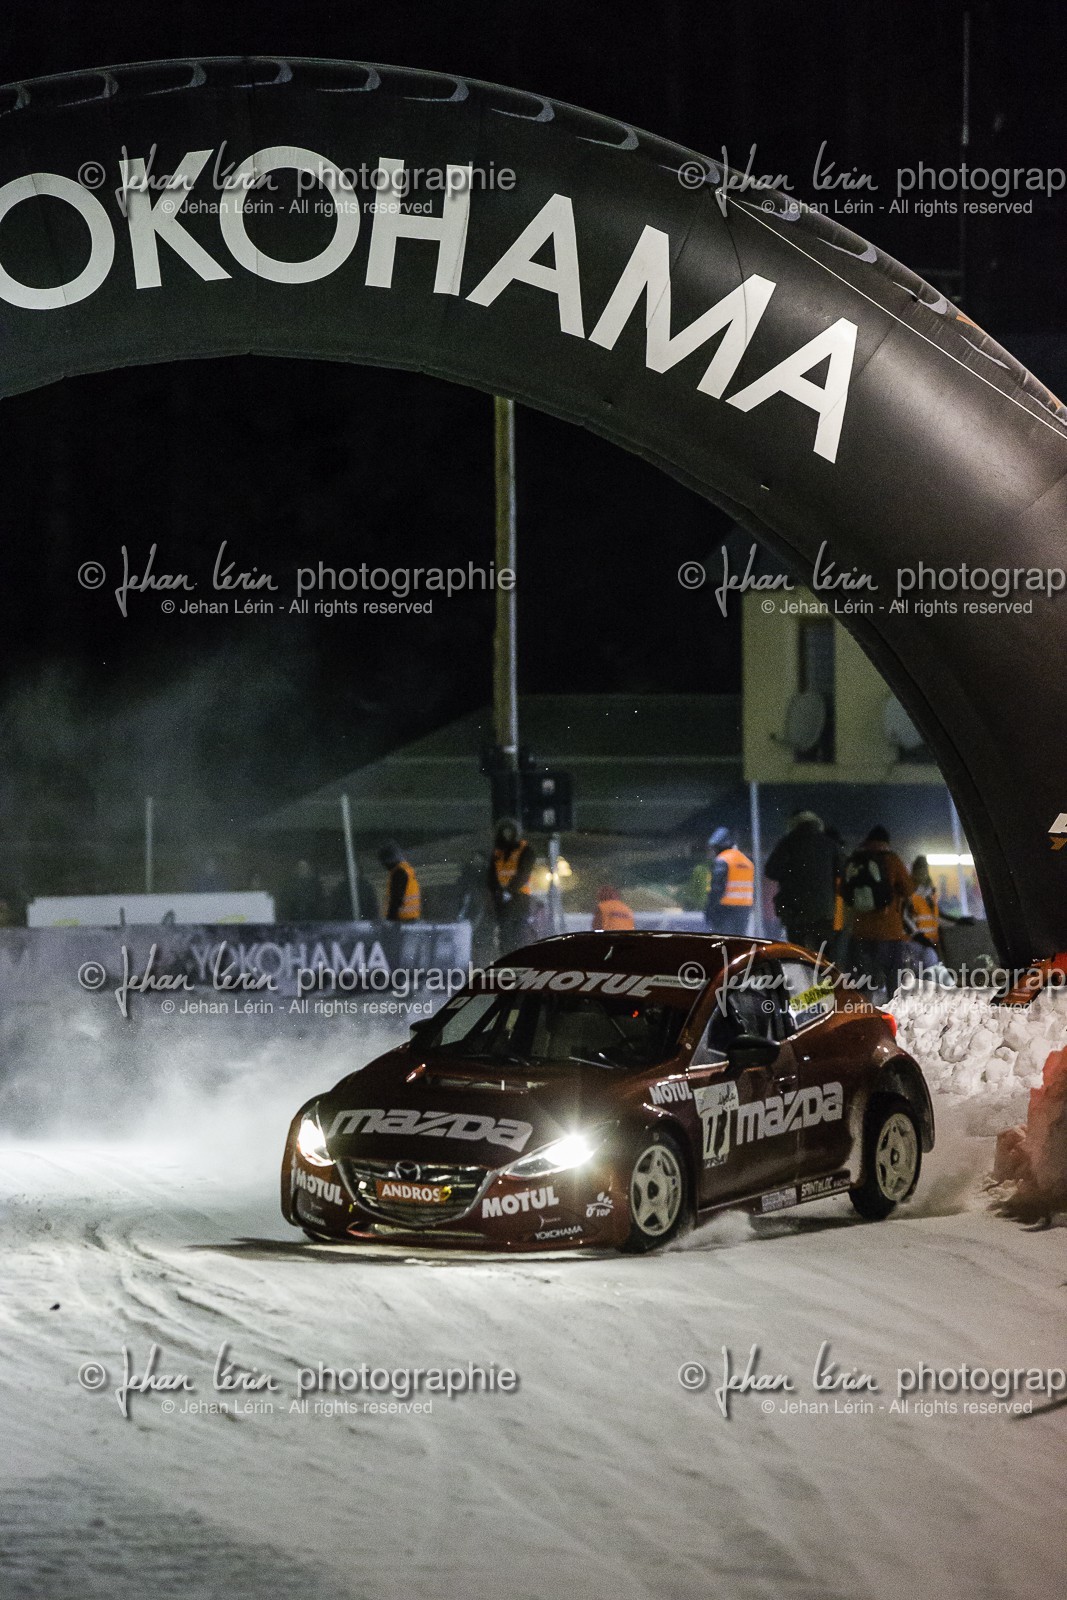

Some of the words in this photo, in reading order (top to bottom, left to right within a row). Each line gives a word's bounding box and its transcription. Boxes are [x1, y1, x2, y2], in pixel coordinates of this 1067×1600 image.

[189, 939, 391, 981] YOKOHAMA
[516, 969, 653, 998] MOTUL
[648, 1080, 693, 1105] MOTUL
[736, 1081, 844, 1145] mazda
[326, 1108, 534, 1153] mazda
[296, 1167, 343, 1206] MOTUL
[381, 1183, 440, 1202] ANDROS
[482, 1186, 559, 1218] MOTUL
[535, 1225, 583, 1240] YOKOHAMA
